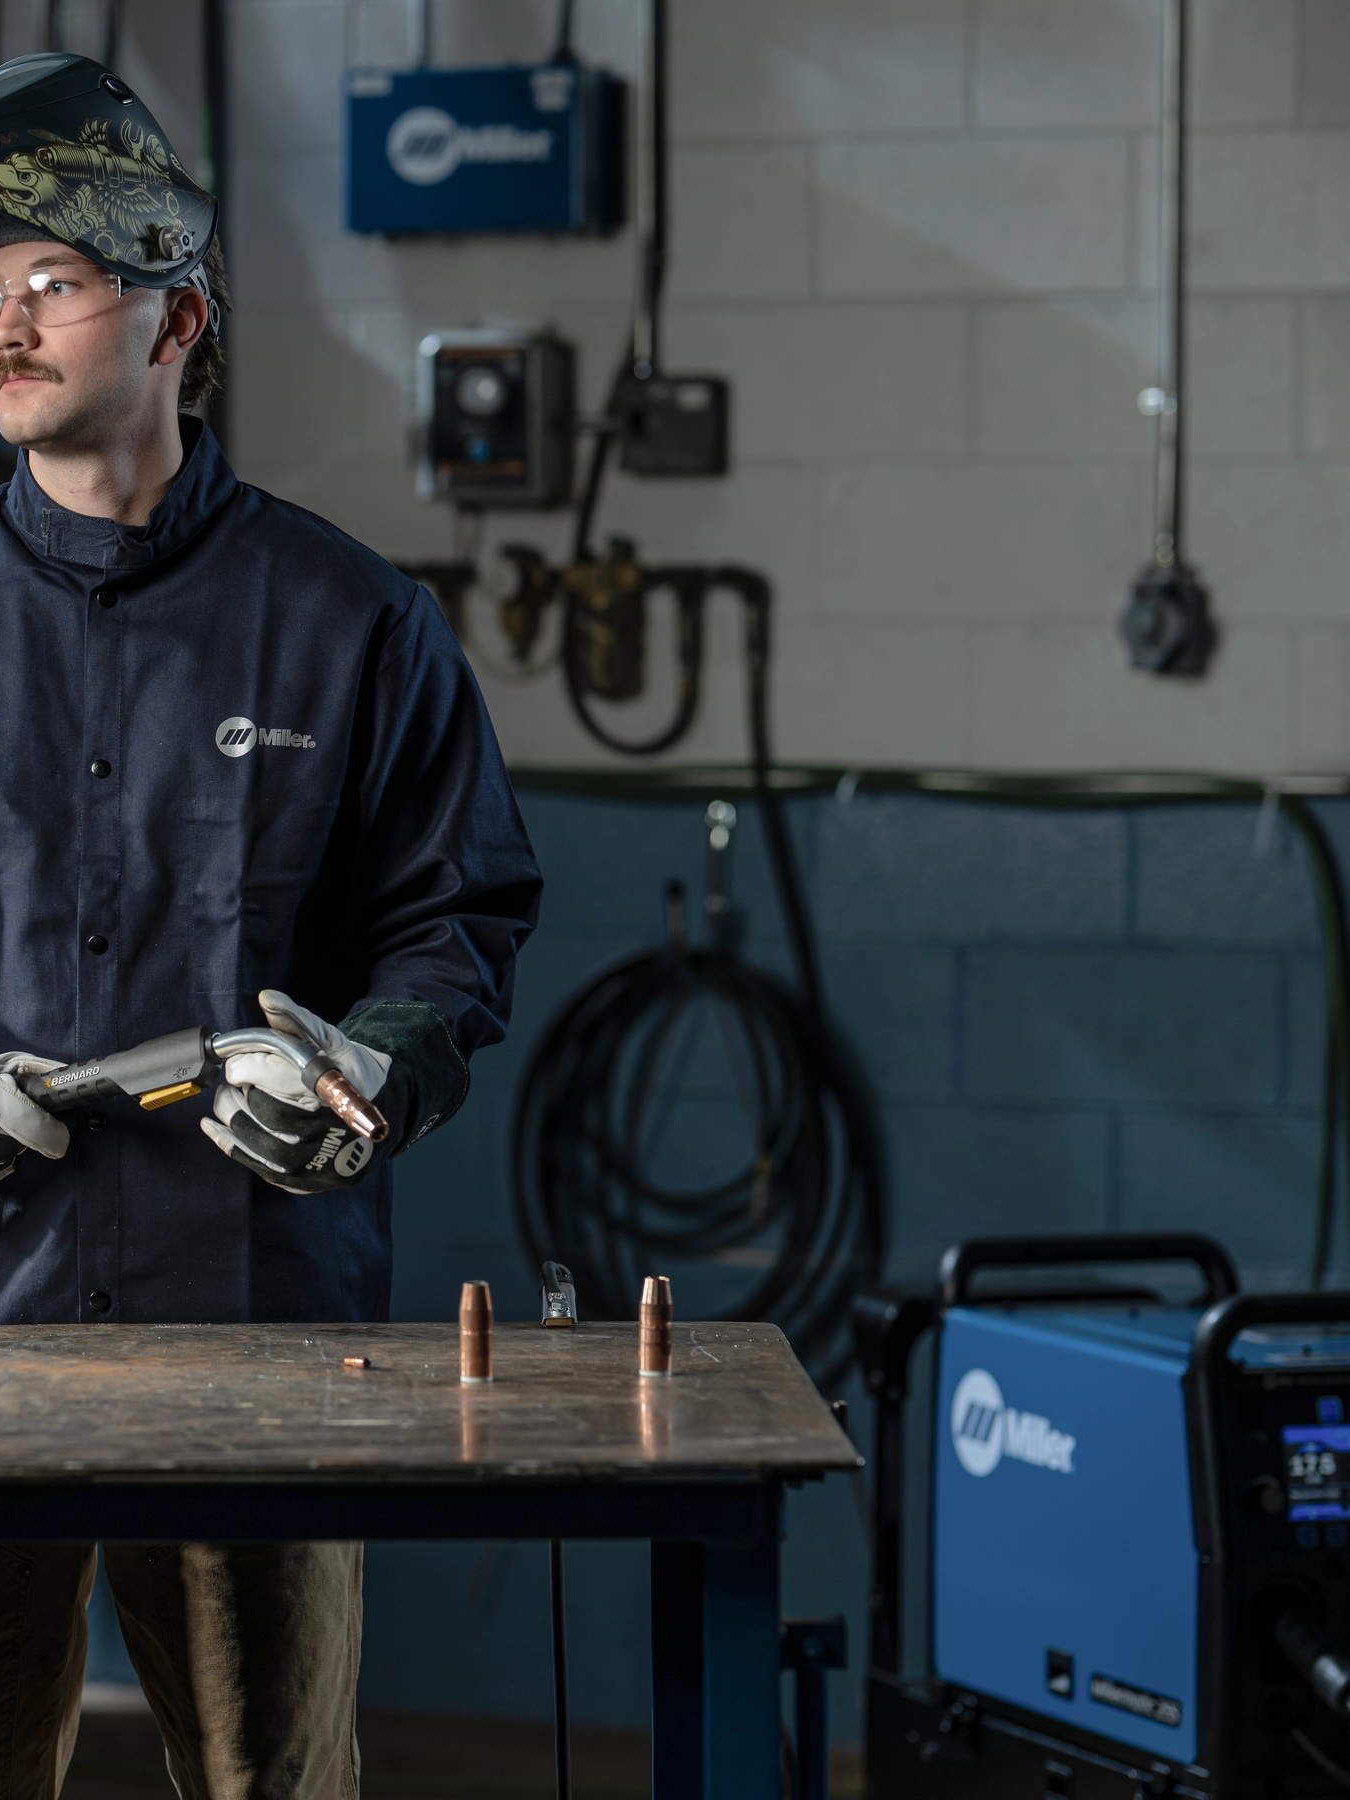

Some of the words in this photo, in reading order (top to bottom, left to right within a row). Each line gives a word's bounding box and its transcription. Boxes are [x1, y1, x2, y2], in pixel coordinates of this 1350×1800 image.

[258, 727, 312, 748] Miller
[51, 1066, 101, 1087] BERNARD
[312, 1126, 347, 1171] Miller
[1003, 1406, 1077, 1475] Miller
